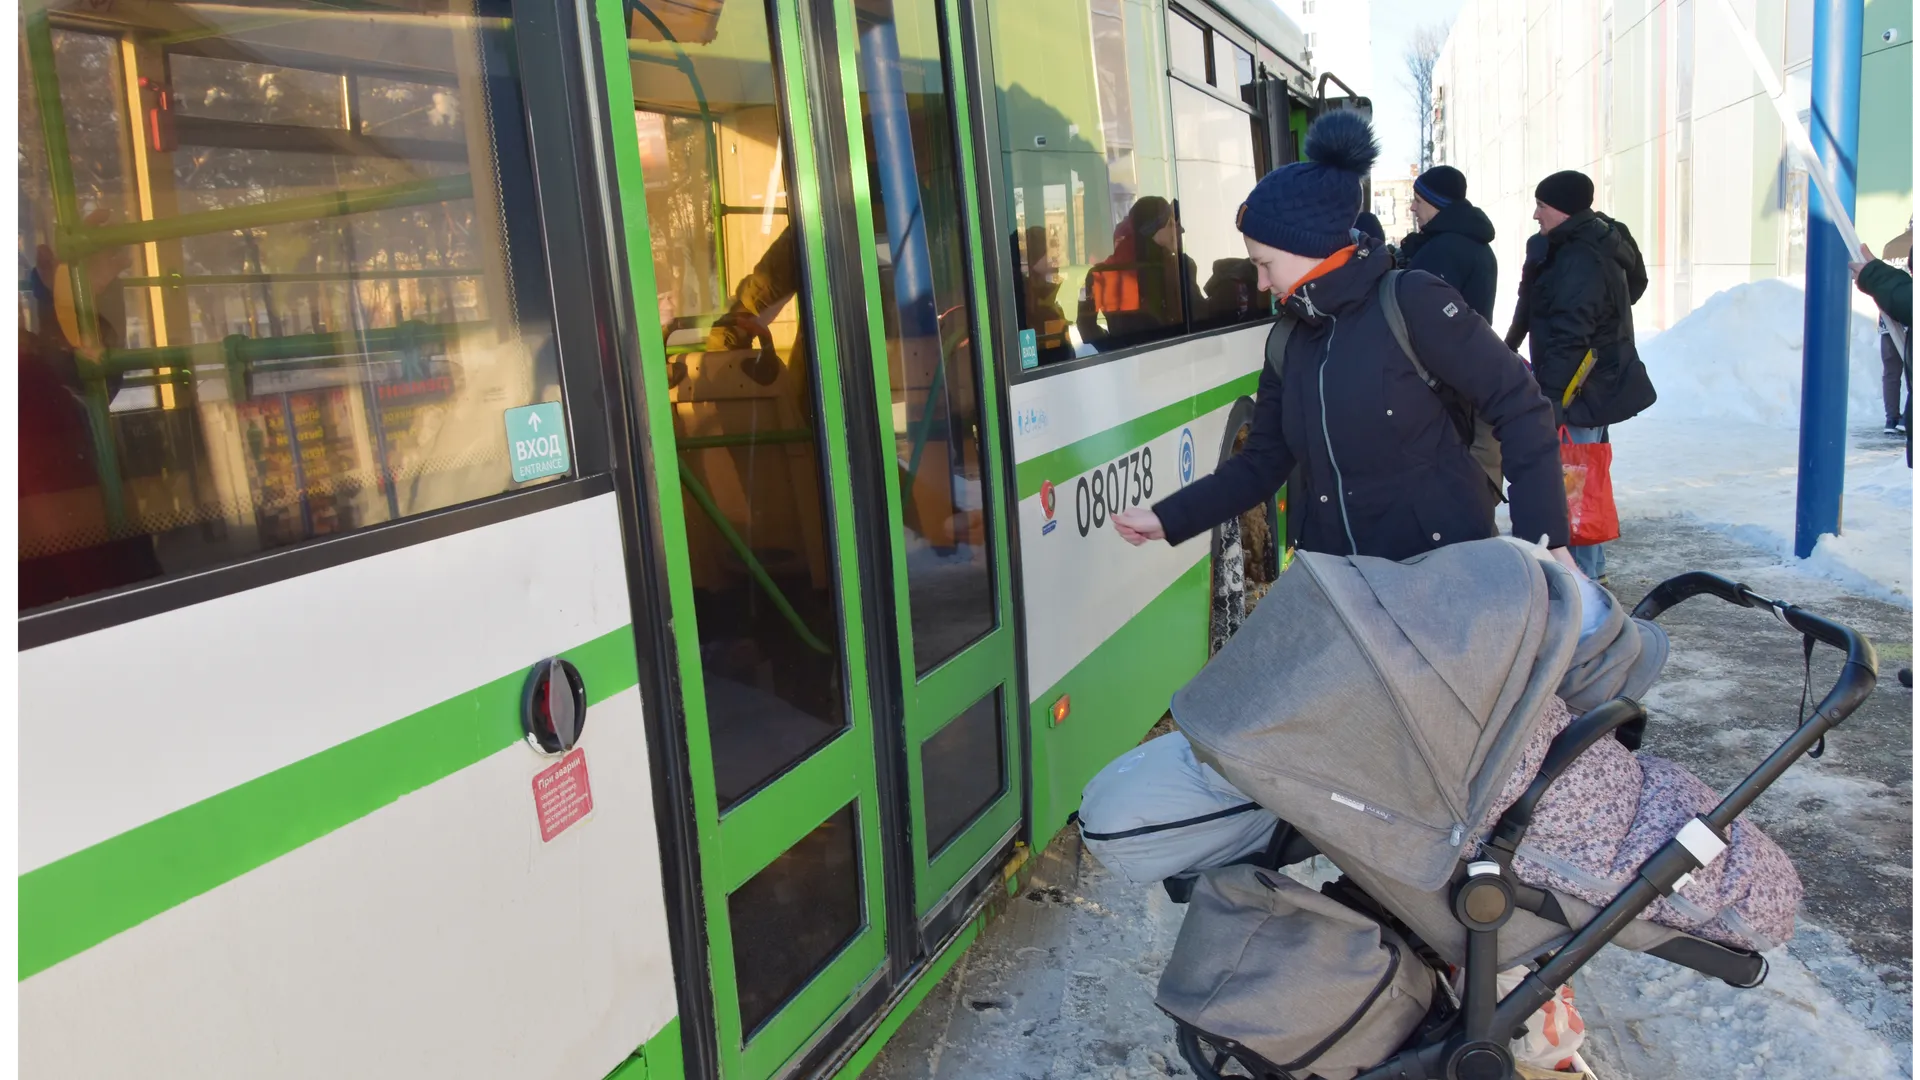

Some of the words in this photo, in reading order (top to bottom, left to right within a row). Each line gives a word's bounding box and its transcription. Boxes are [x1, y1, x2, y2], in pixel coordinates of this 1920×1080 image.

[516, 434, 562, 461] ВХОД
[520, 459, 563, 477] ENTRANCE
[1076, 446, 1153, 537] 080738
[537, 775, 554, 790] При
[555, 756, 581, 780] аварии
